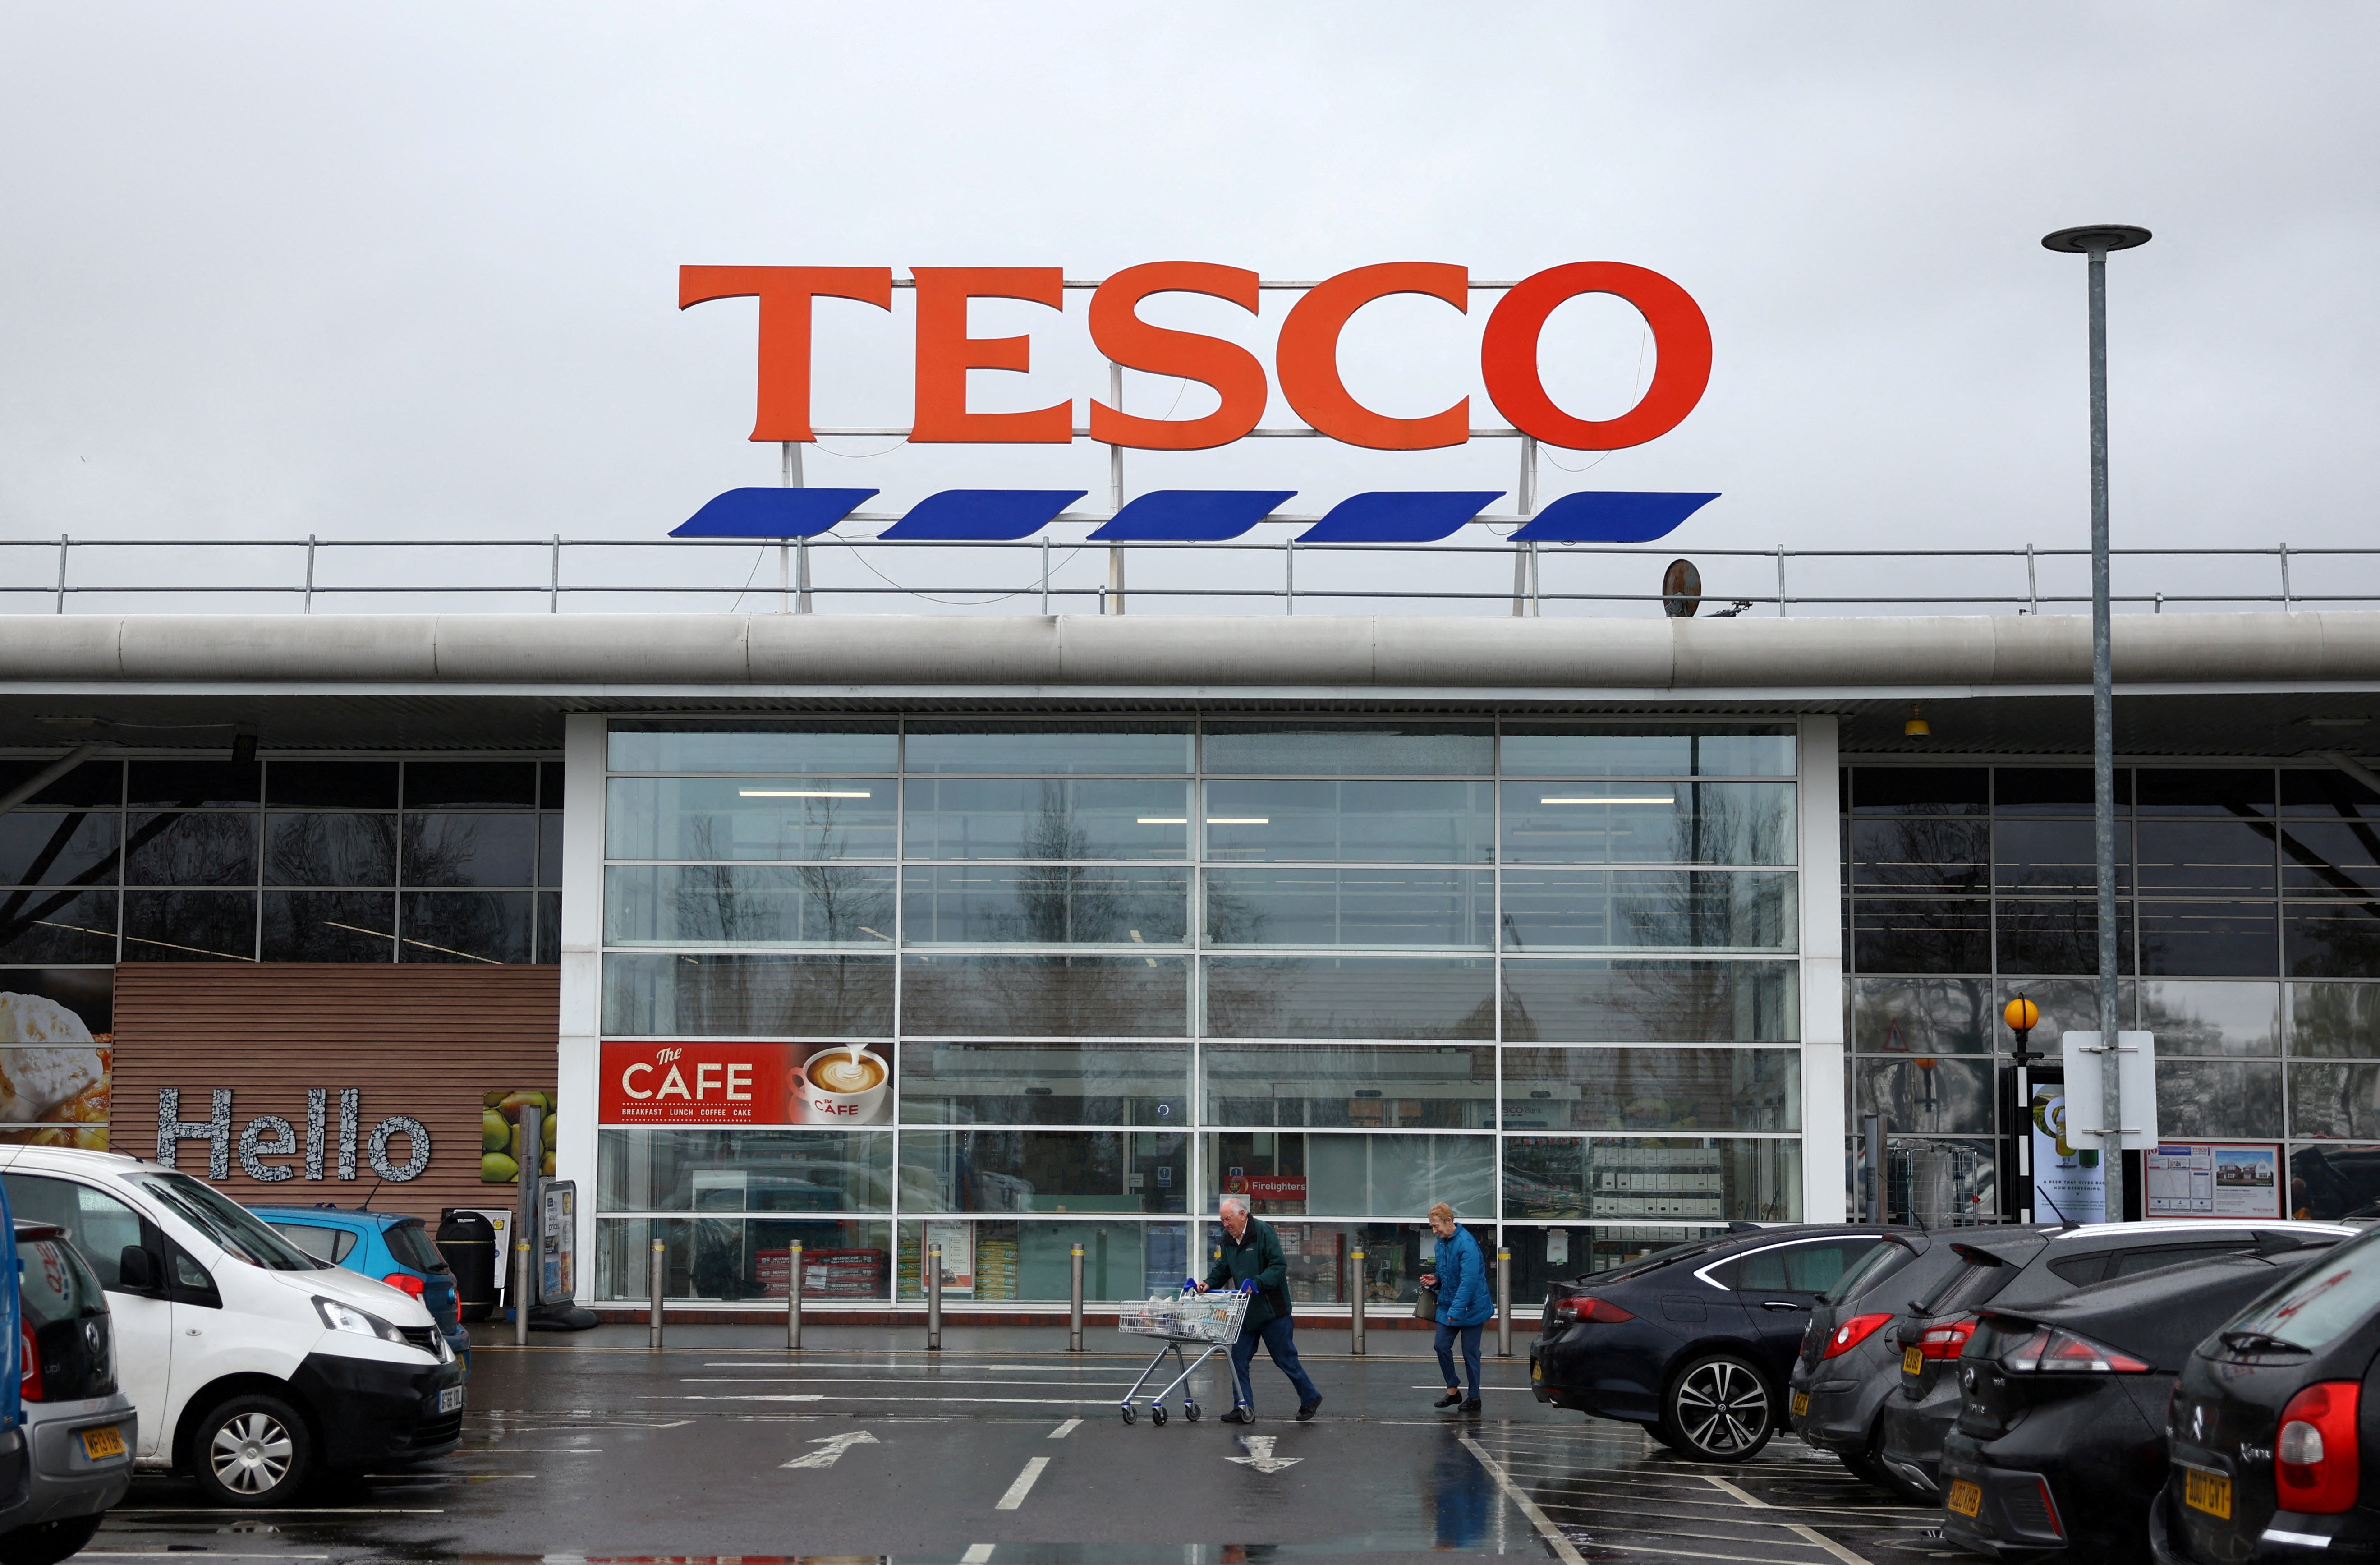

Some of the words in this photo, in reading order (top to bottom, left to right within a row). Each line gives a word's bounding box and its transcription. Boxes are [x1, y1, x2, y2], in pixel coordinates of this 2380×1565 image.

[679, 261, 1712, 451] TESCO
[656, 1047, 682, 1065] The
[622, 1062, 753, 1100] CAFE
[814, 1100, 859, 1115] CAFE
[157, 1088, 431, 1182] Hello
[1252, 1182, 1306, 1192] Firelighters
[45, 1363, 60, 1374] up!
[442, 1391, 453, 1409] BT66
[85, 1432, 108, 1455] MF13
[104, 1430, 122, 1450] YBK
[1963, 1487, 1979, 1512] KHB
[2209, 1478, 2226, 1512] GVT
